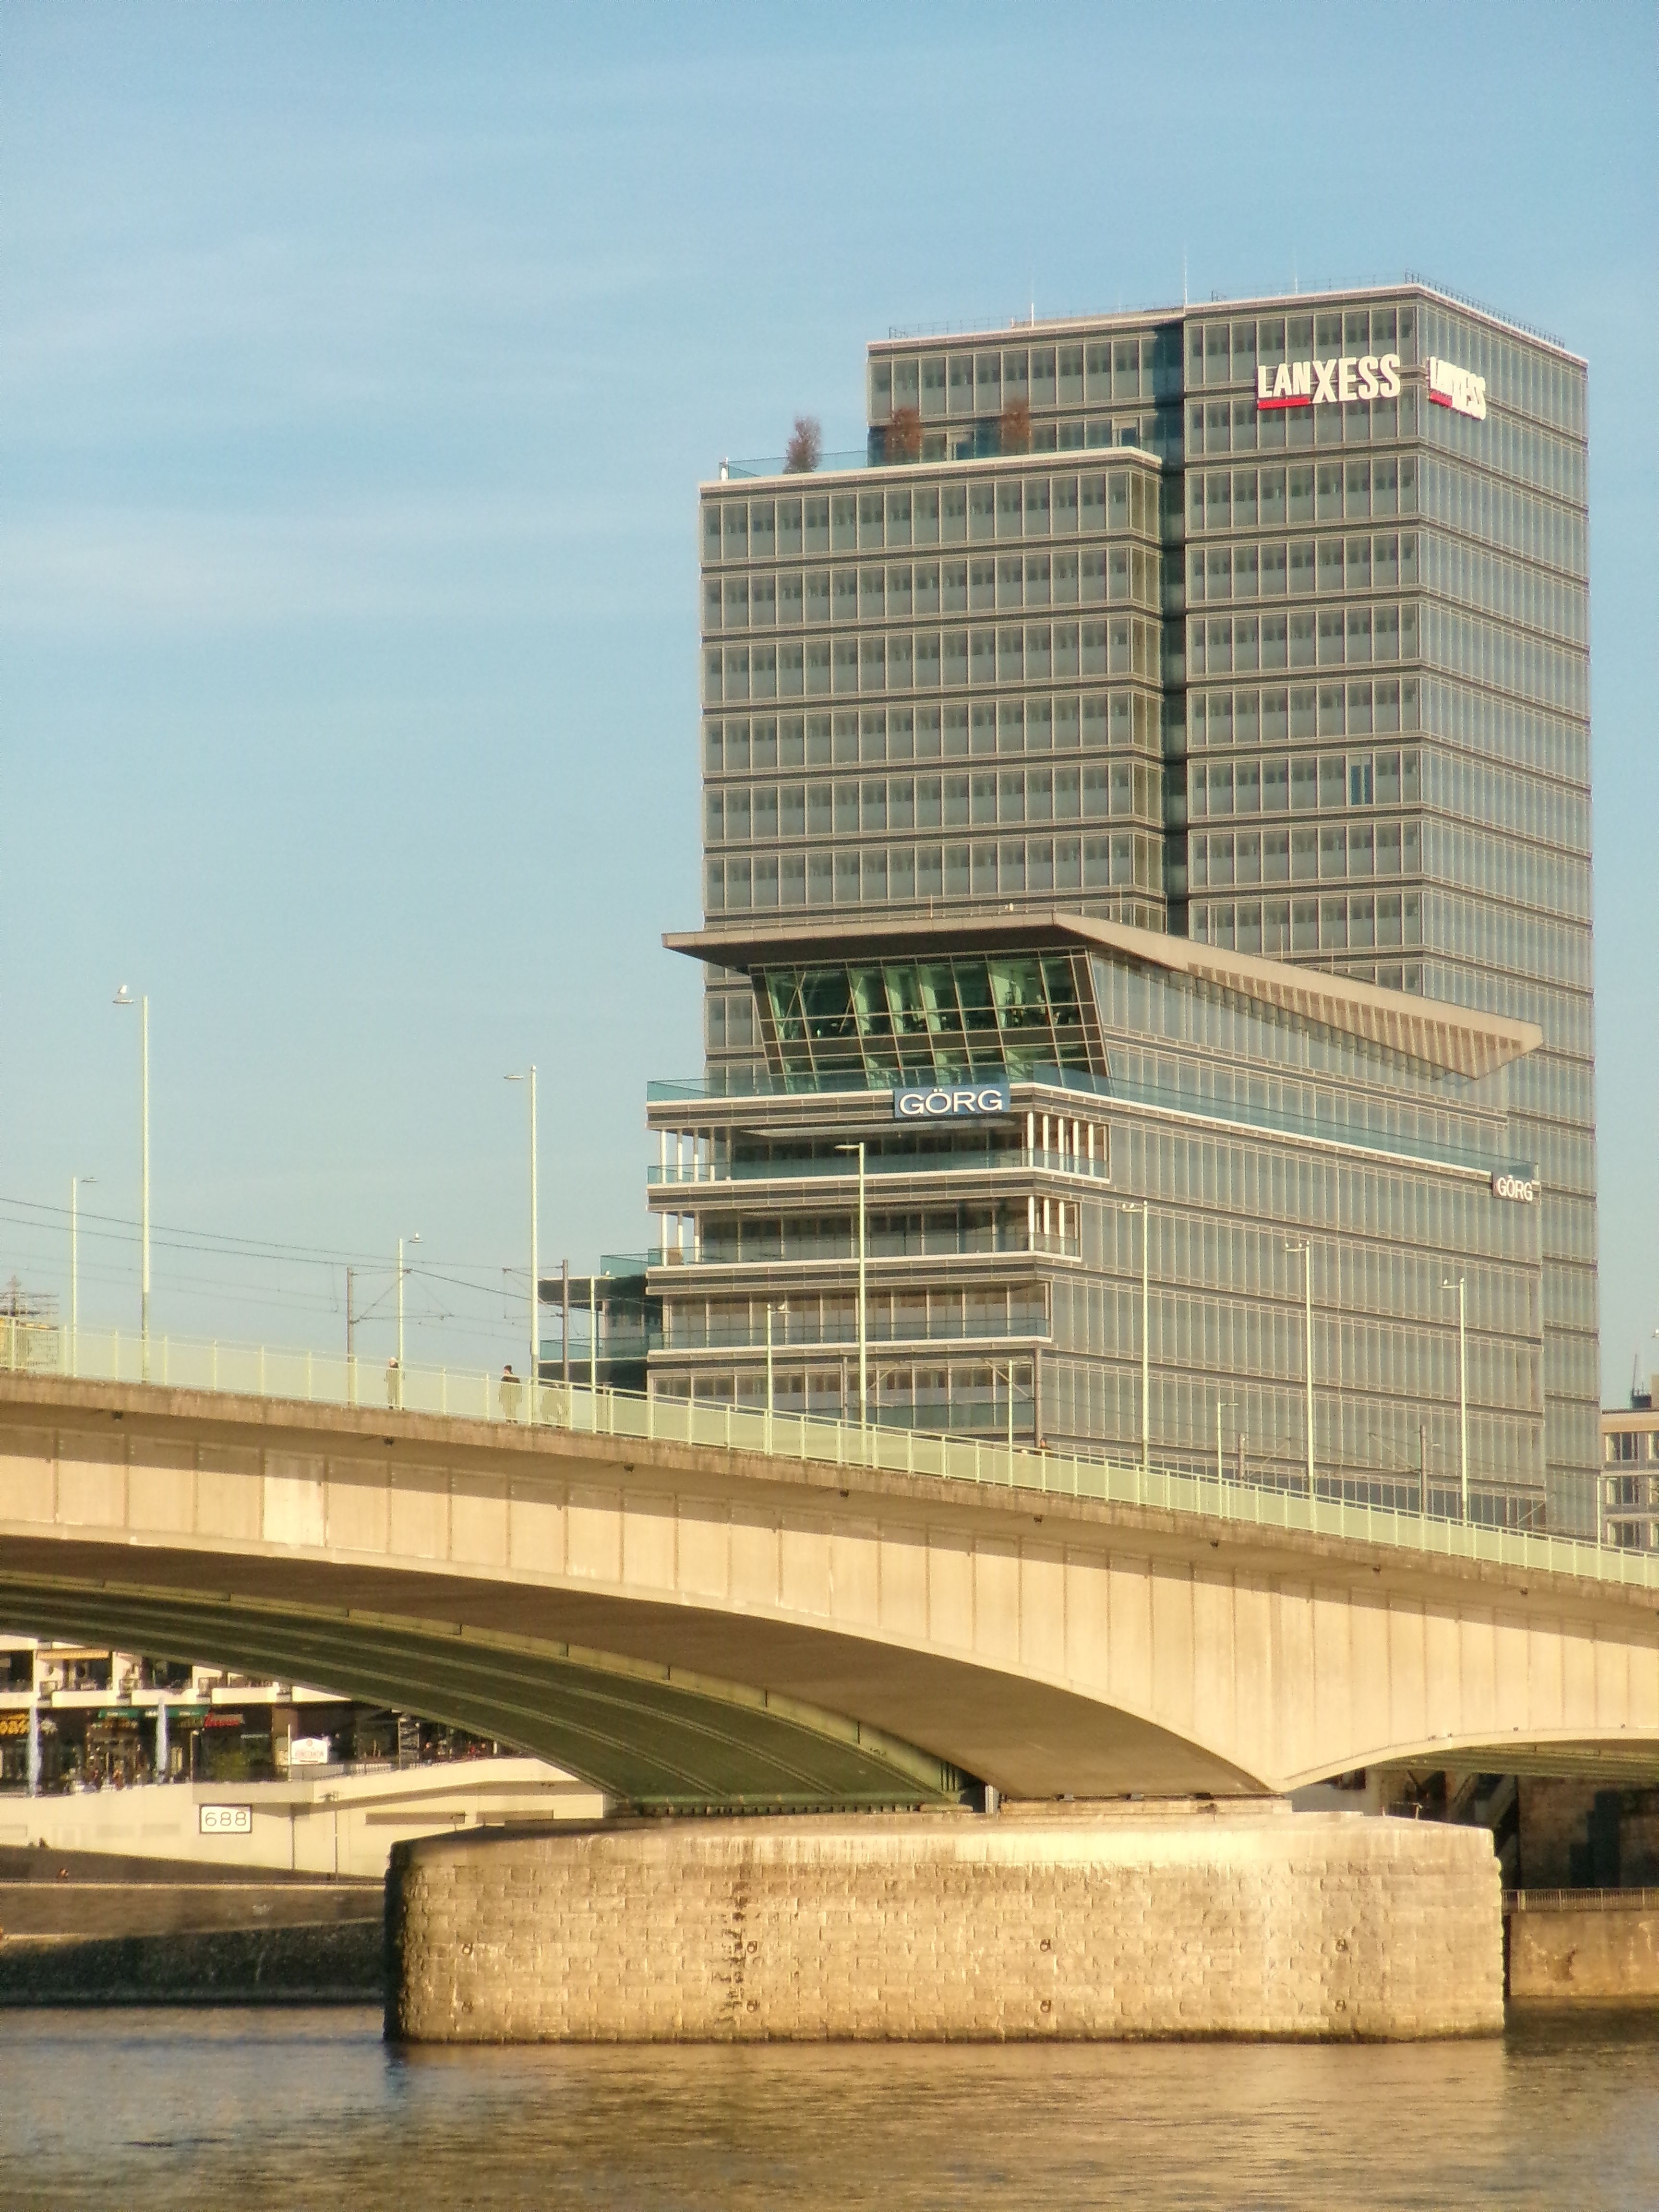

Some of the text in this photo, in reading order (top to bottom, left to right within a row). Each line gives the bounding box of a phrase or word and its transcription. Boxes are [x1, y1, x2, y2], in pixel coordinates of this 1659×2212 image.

[1257, 354, 1401, 404] LANXESS
[900, 1088, 1003, 1115] GÖRG
[205, 1811, 247, 1827] 688
